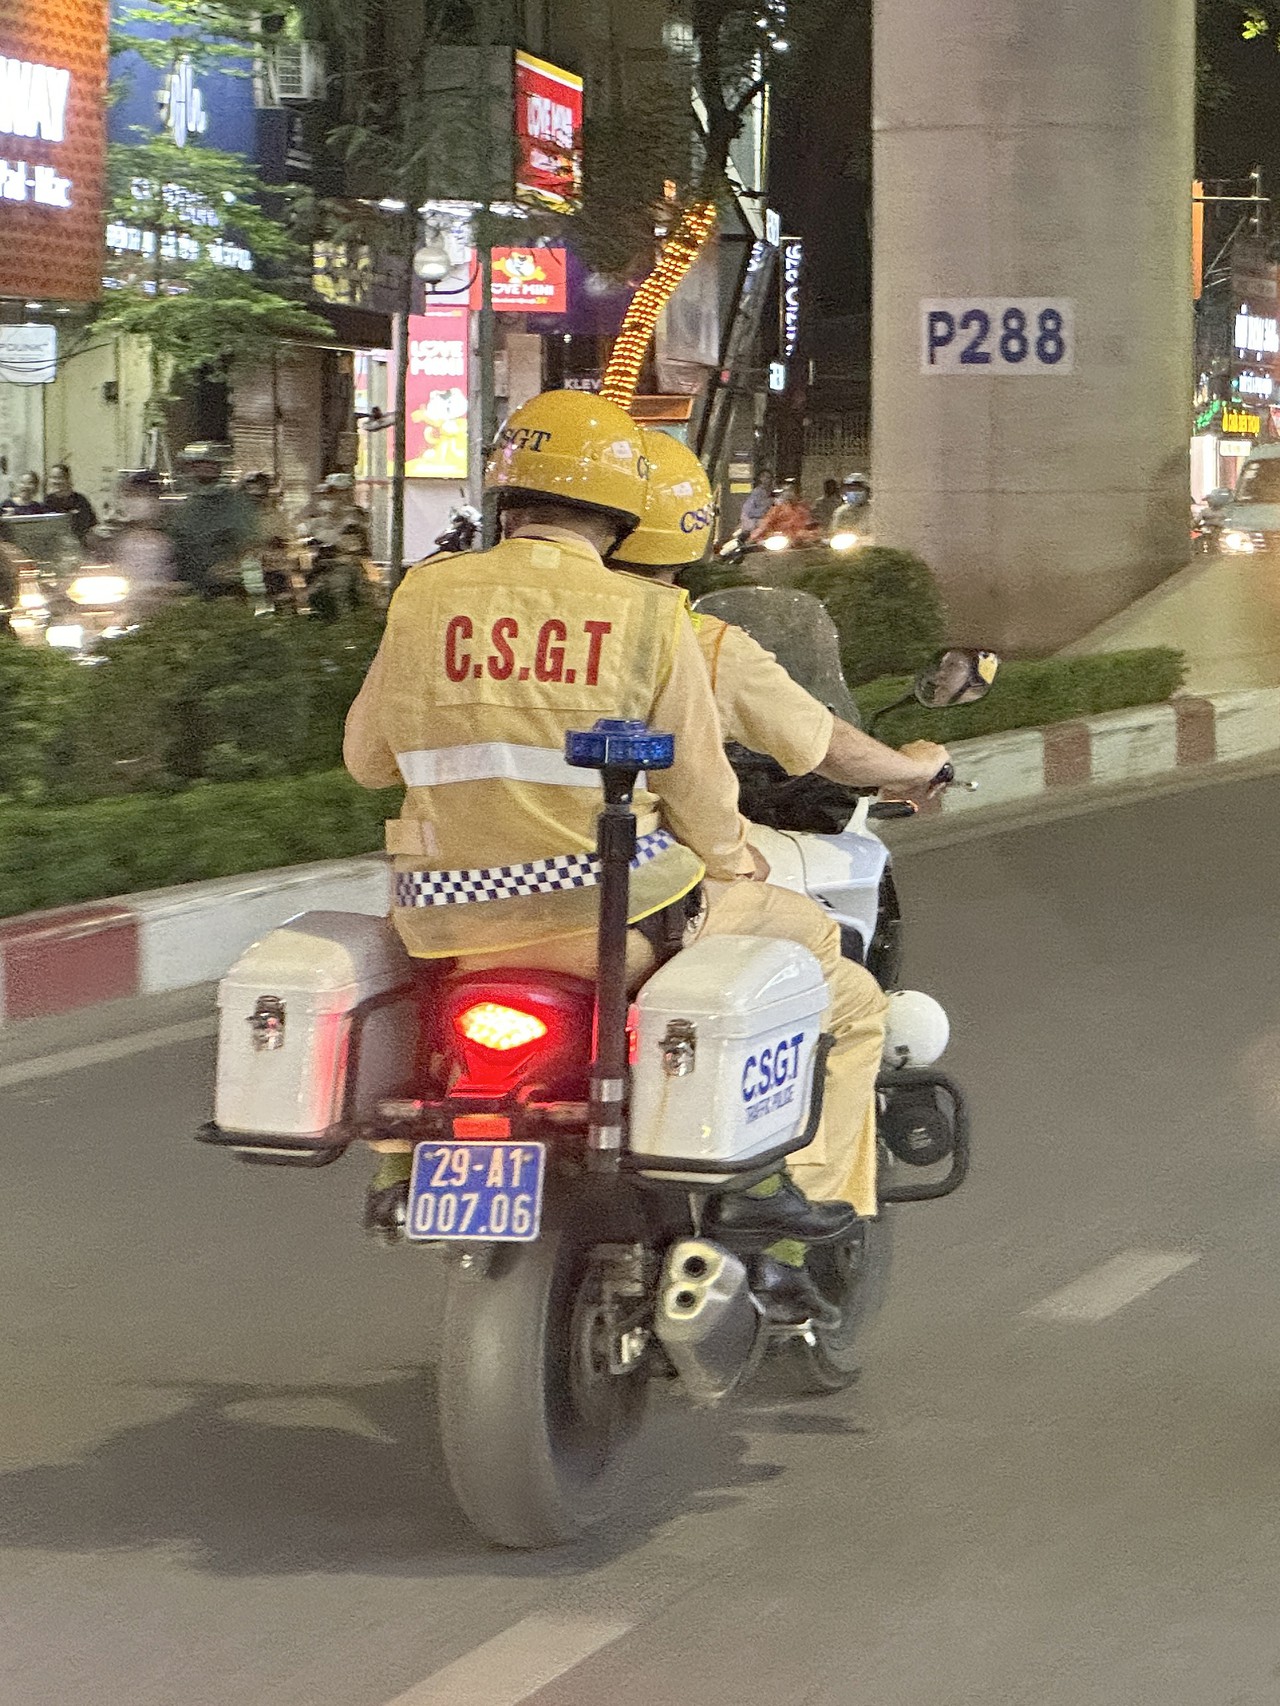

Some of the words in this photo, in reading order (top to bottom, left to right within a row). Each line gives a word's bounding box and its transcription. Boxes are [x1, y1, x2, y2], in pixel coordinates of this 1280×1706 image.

[491, 283, 520, 296] OVE
[928, 307, 1065, 364] P288
[444, 614, 613, 687] C.S.G.T
[429, 1147, 524, 1188] 29-A1
[415, 1192, 533, 1234] 007.06
